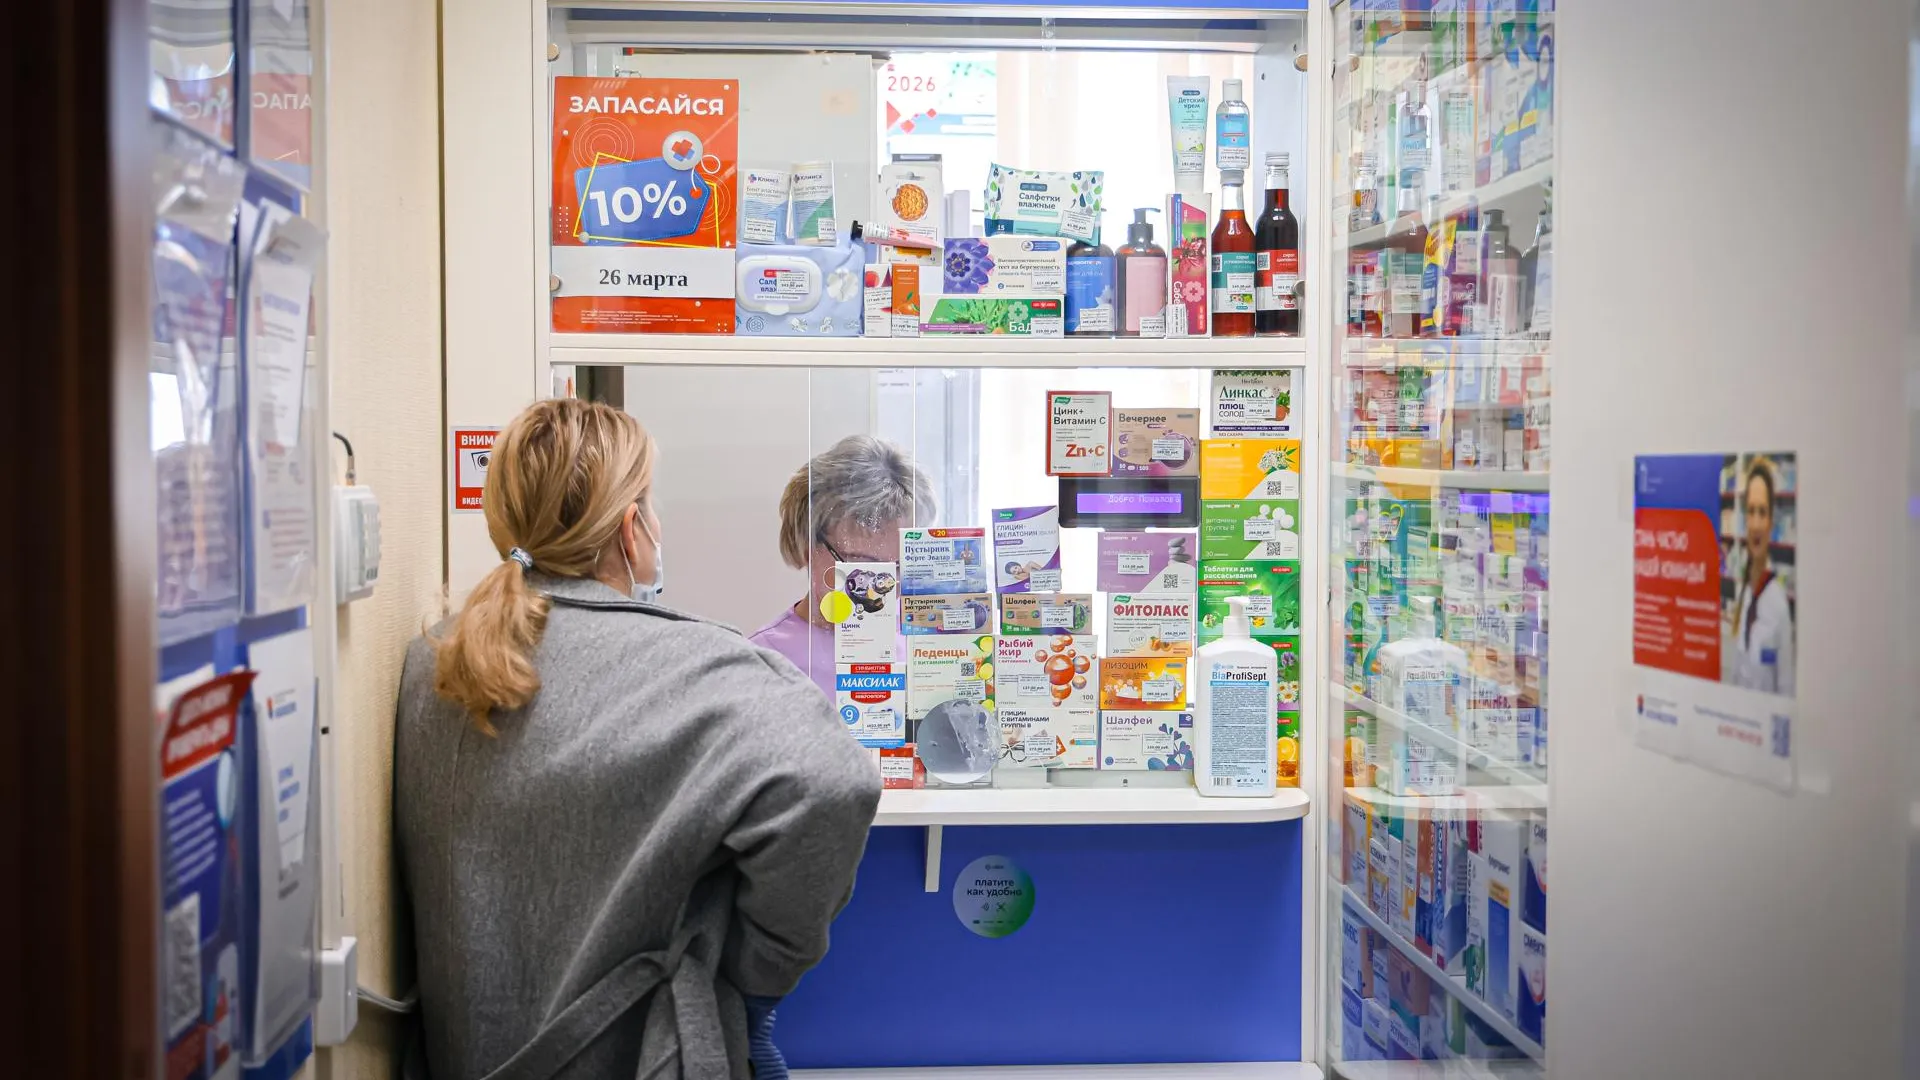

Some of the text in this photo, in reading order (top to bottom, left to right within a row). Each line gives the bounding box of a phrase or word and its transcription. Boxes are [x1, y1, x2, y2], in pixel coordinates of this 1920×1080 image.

[888, 76, 936, 91] 2026
[569, 94, 724, 115] ЗАПАСАЙСЯ
[1019, 193, 1060, 203] Салфетки
[590, 181, 687, 226] 10%
[1018, 202, 1055, 210] влажные
[599, 268, 689, 288] 26 марта
[1219, 385, 1265, 399] Линкас
[1053, 407, 1084, 416] Цинк+
[1053, 416, 1096, 425] Витамин
[1118, 413, 1167, 425] Вечернее
[461, 435, 495, 446] ВНИМ
[1065, 444, 1105, 458] Zn+C
[1108, 494, 1135, 503] Добро
[904, 546, 950, 554] Пустырник
[1006, 597, 1037, 605] Шалфей
[1113, 604, 1189, 617] ФИТОЛАКС
[841, 622, 861, 630] Цинк
[998, 637, 1033, 648] Рыбий
[914, 649, 969, 659] Леденцы
[998, 648, 1022, 657] жир
[1105, 662, 1148, 670] ЛИЗОЦИМ
[841, 678, 900, 688] МАКСИЛАК
[845, 709, 854, 721] 9
[1106, 715, 1153, 726] Шалфей
[975, 879, 1015, 887] платите
[967, 886, 1023, 897] как удобно
